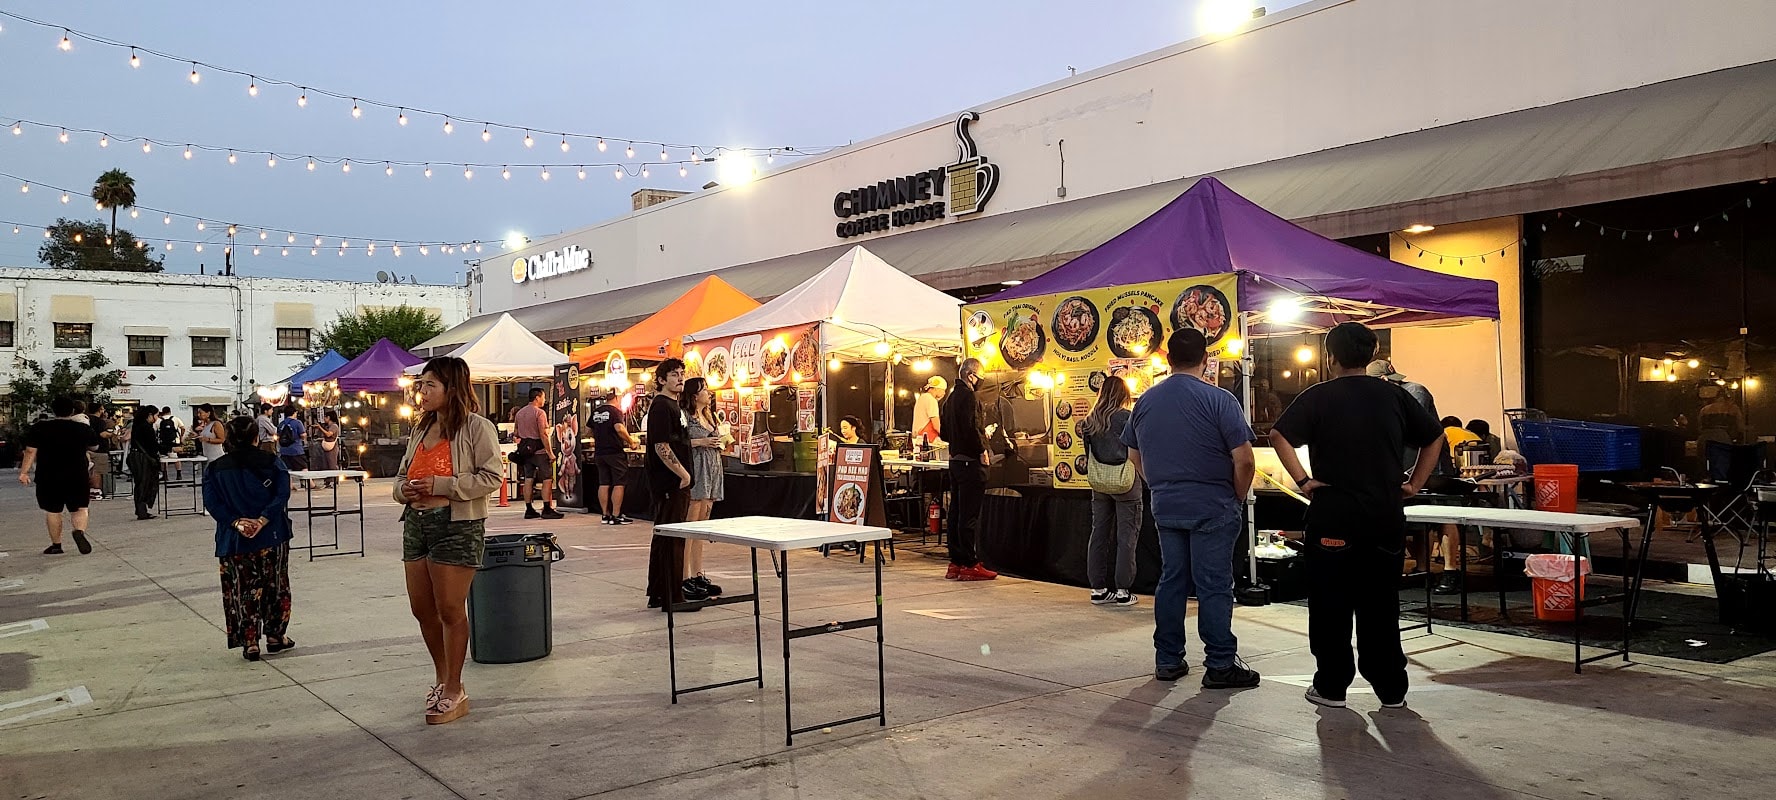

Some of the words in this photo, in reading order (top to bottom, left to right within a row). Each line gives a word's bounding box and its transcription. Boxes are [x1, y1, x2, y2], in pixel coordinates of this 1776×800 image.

[834, 167, 945, 218] CHIMNEY
[836, 214, 889, 238] COFFEE
[892, 202, 945, 227] HOUSE
[1104, 298, 1117, 313] FRIED
[1117, 290, 1140, 301] MUSSELS
[1140, 290, 1164, 307] PANCAKE
[1080, 345, 1099, 361] NOODLE
